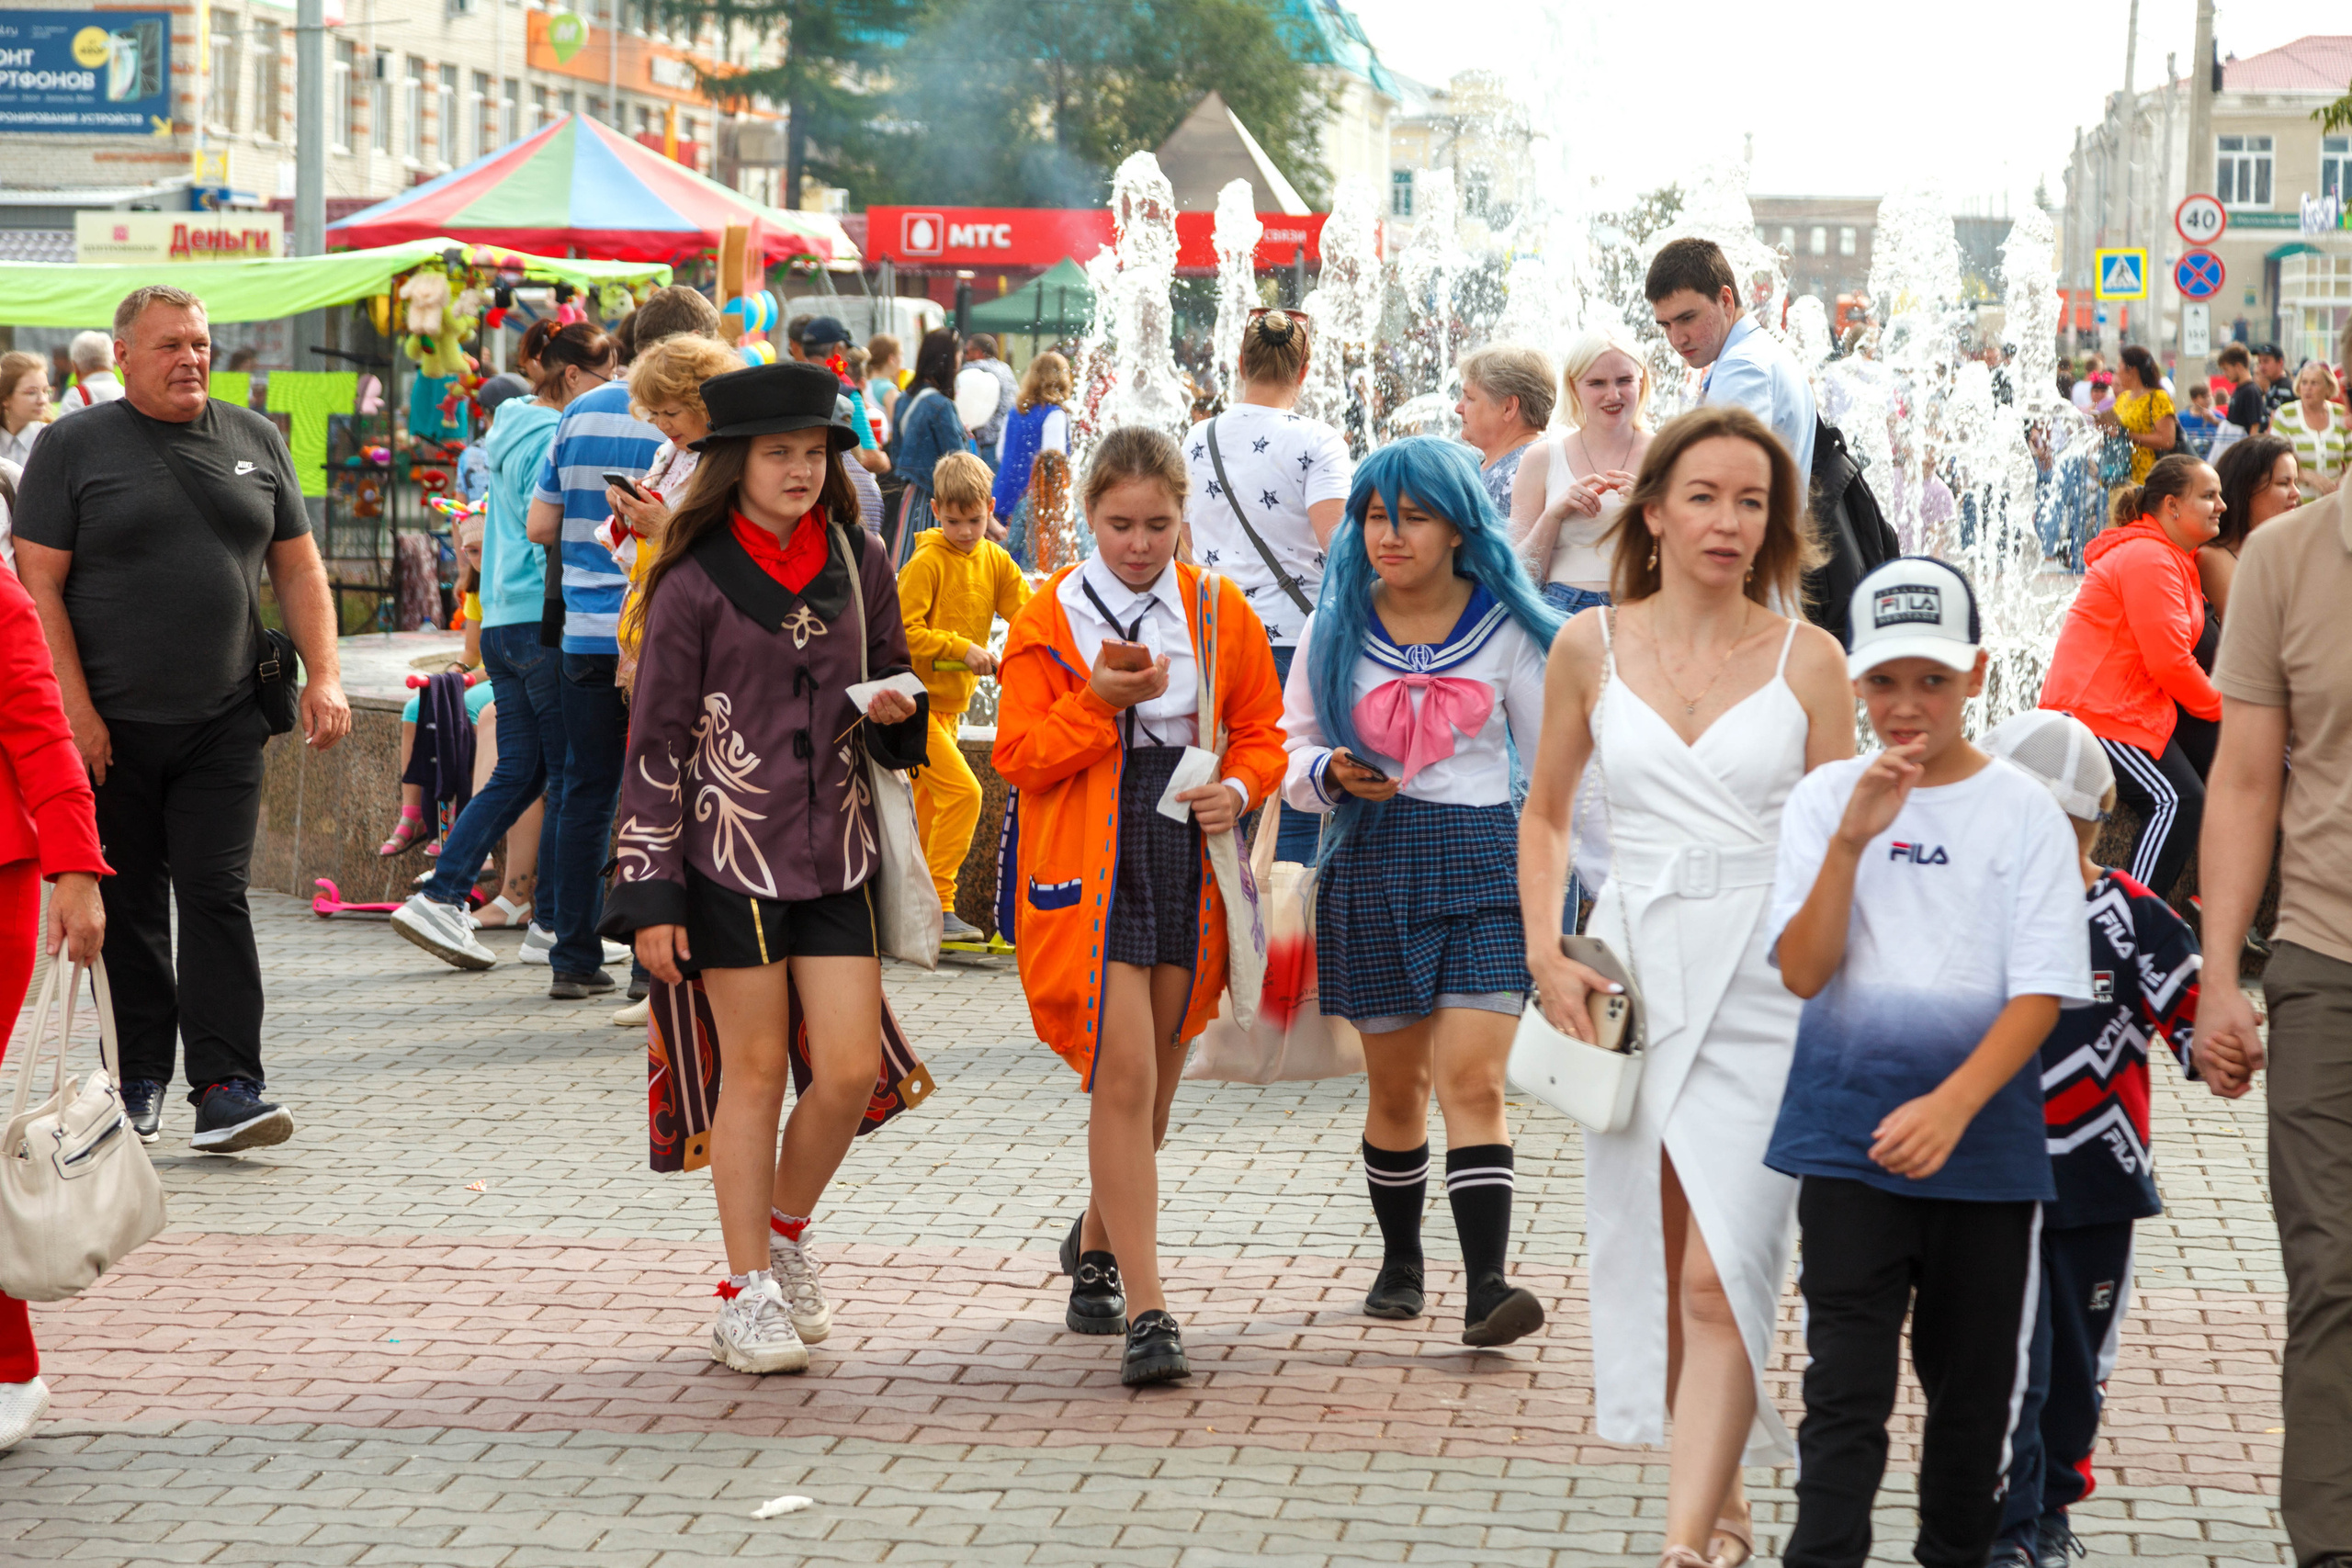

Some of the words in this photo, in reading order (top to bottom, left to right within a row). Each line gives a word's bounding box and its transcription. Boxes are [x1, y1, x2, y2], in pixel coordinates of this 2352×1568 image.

[0, 71, 96, 90] РТФОНОВ
[2187, 209, 2216, 230] 40
[170, 223, 269, 257] Деньги
[948, 223, 1012, 248] МТС
[1881, 595, 1936, 614] FILA
[1890, 841, 1949, 865] FILA
[2095, 908, 2135, 960] FILA
[2095, 1004, 2133, 1050] FILA
[2100, 1126, 2137, 1174] FILA
